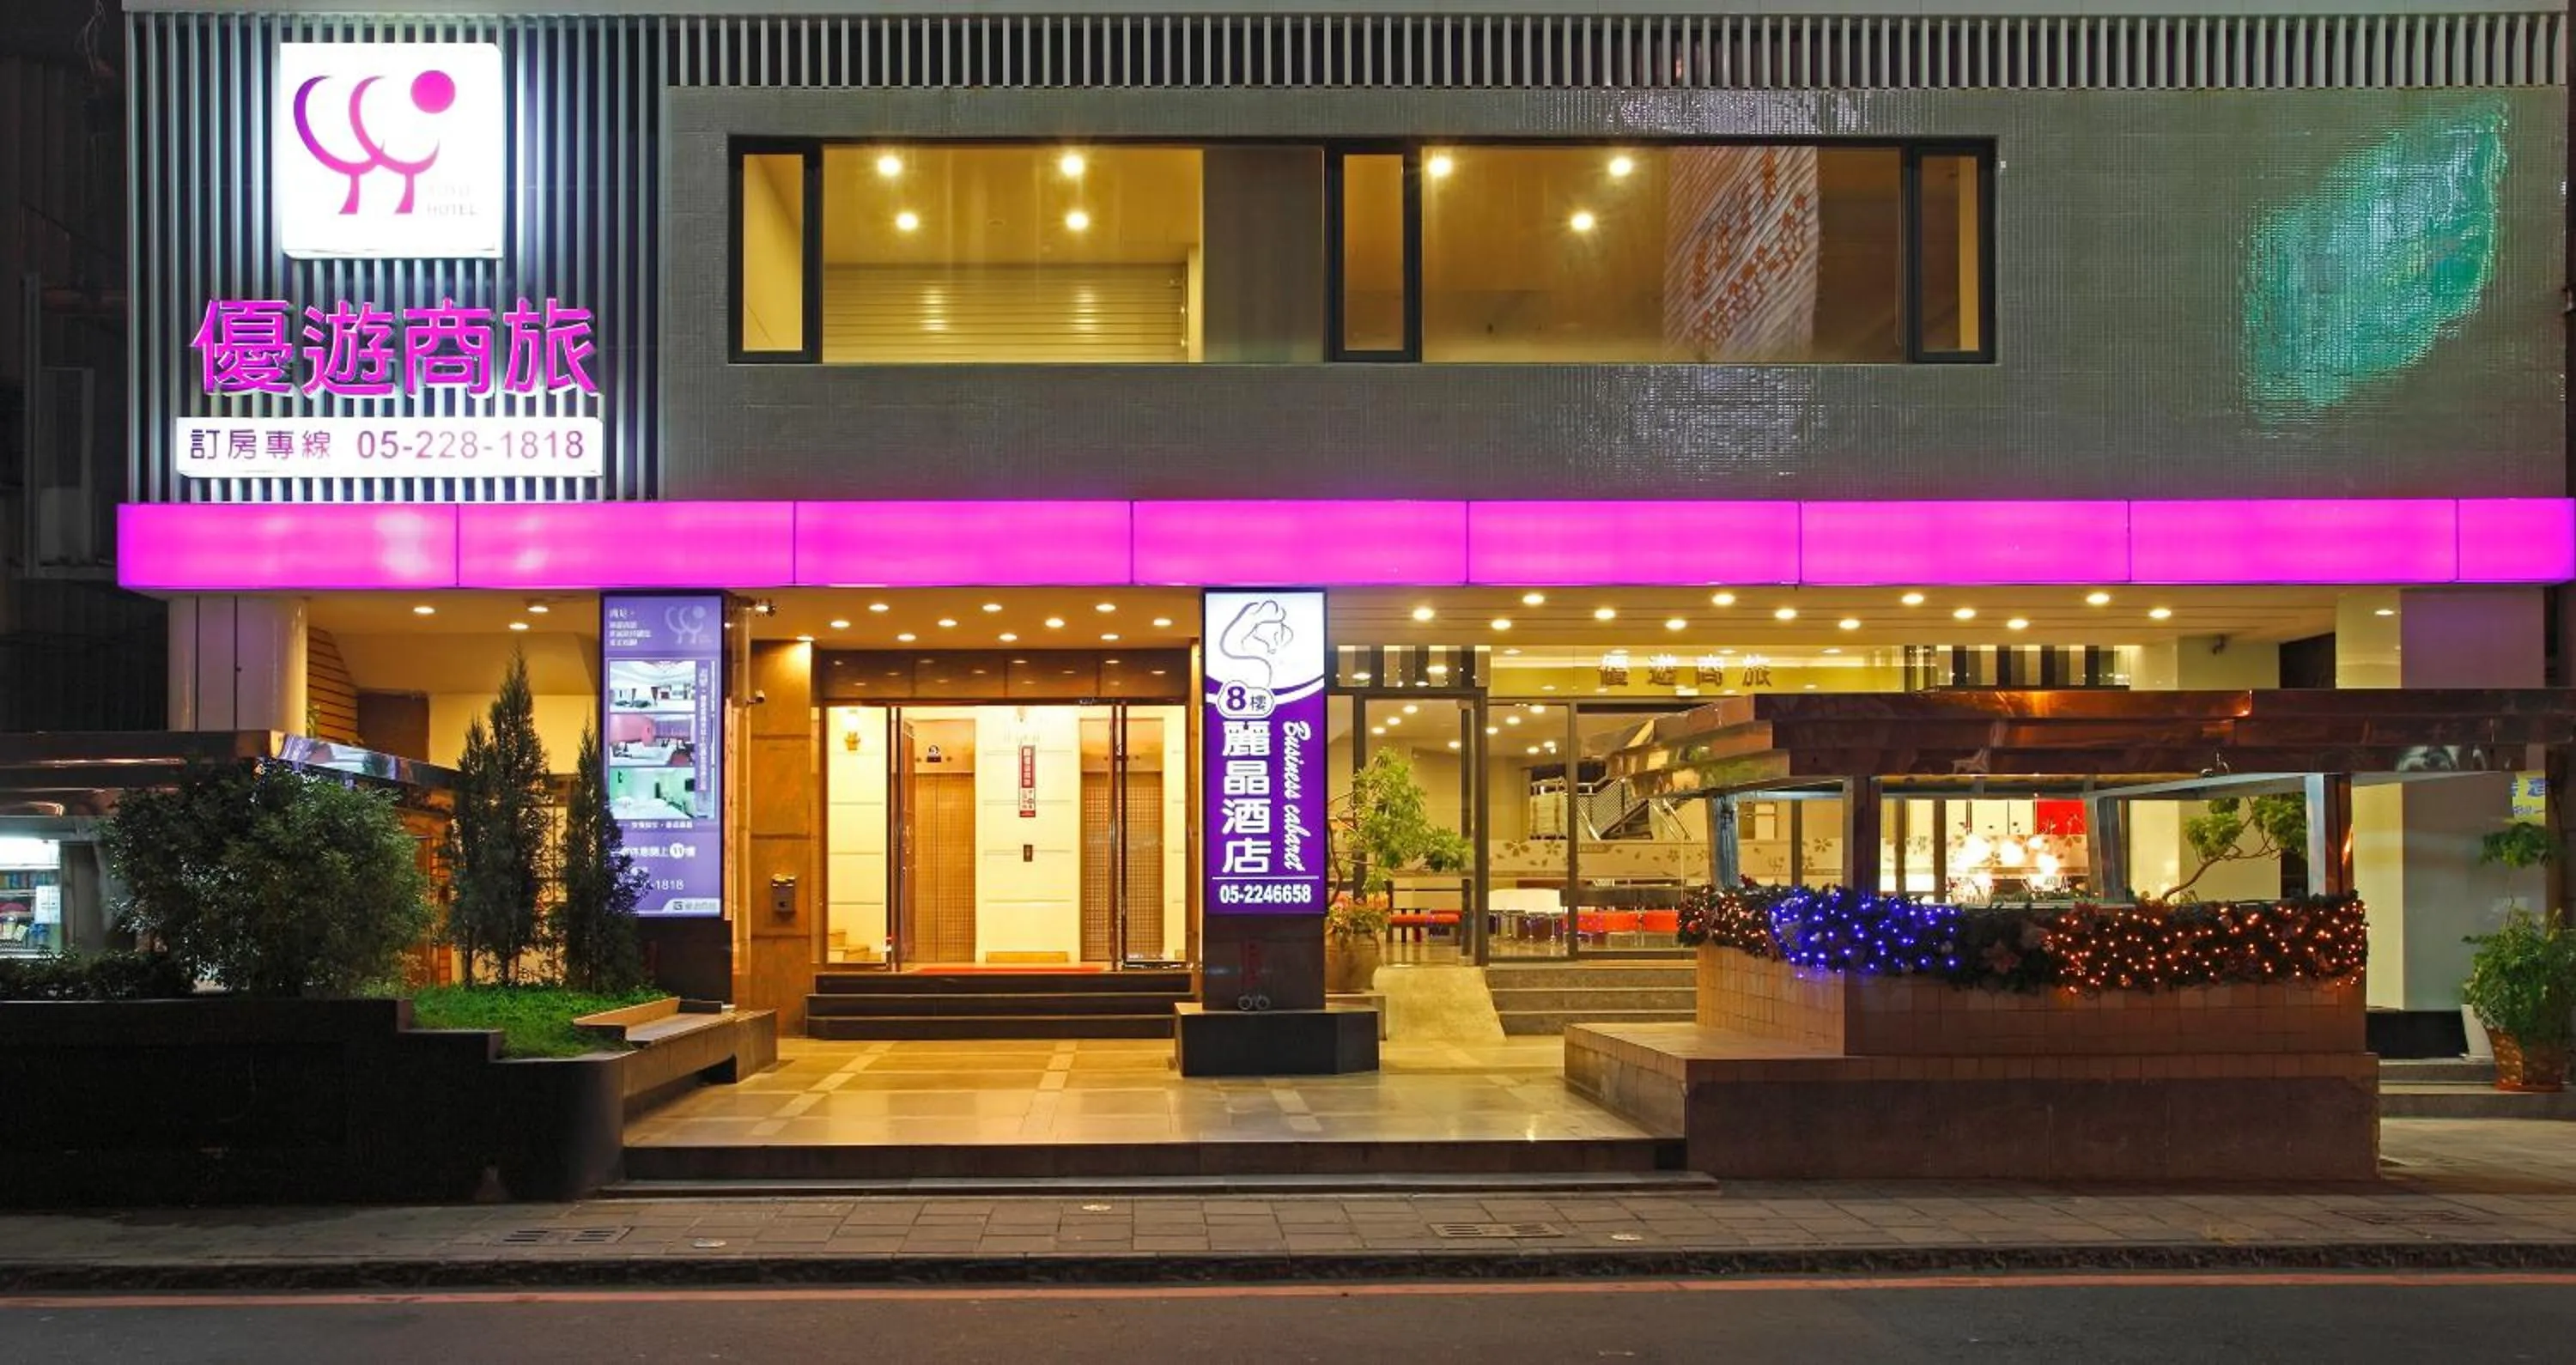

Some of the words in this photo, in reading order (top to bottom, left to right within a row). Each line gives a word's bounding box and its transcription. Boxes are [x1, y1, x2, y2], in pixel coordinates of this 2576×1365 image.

[191, 298, 600, 397] 優遊商旅
[189, 428, 332, 460] 訂房專線
[357, 429, 585, 460] 05-228-1818
[1597, 653, 1772, 687] 優遊商旅
[1283, 720, 1311, 800] Business
[1223, 720, 1272, 873] 麗晶酒店
[1283, 804, 1312, 871] cabaret
[1219, 883, 1311, 904] 05-2246658
